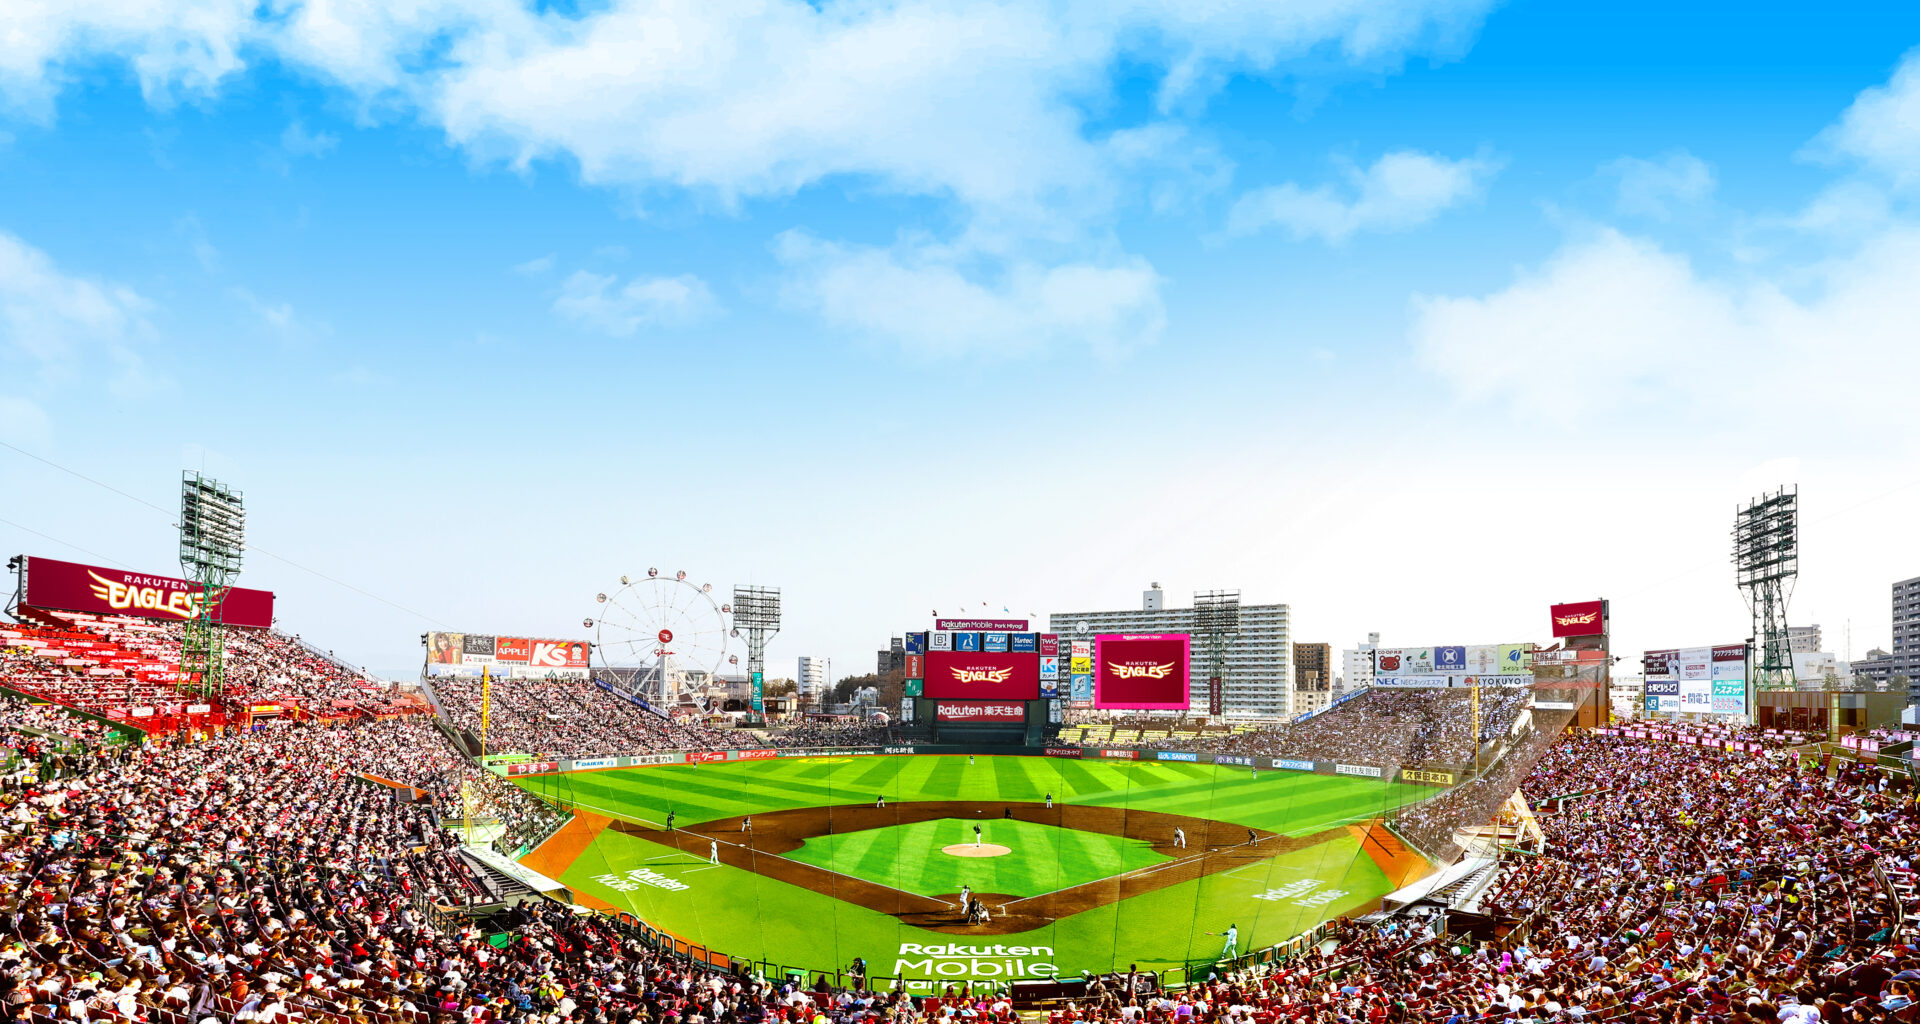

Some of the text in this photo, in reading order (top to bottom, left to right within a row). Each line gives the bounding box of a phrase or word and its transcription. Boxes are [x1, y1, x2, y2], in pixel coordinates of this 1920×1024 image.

[124, 574, 188, 590] RAKUTEN
[98, 576, 212, 619] EAGLES
[941, 620, 971, 630] Rakuten
[971, 621, 993, 629] Mobile
[1557, 613, 1595, 626] EAGLES
[986, 634, 1006, 643] Fuji
[498, 647, 529, 656] APPLE
[955, 668, 1008, 683] EAGLES
[1113, 664, 1170, 679] EAGLES
[1376, 678, 1399, 686] NEC
[1713, 685, 1744, 694] トスネット
[1648, 698, 1657, 707] JR
[1687, 692, 1710, 704] 関電工
[937, 704, 1024, 719] Rakuten 楽天生命
[640, 756, 668, 764] 東北電力
[1171, 753, 1197, 761] SANKYU
[517, 762, 550, 774] やまや
[1337, 764, 1380, 777] 三井住友銀行
[1405, 770, 1449, 783] 久保田本店
[624, 867, 690, 892] Rakuten
[899, 943, 1054, 959] Rakuten
[893, 958, 1060, 977] Mobile
